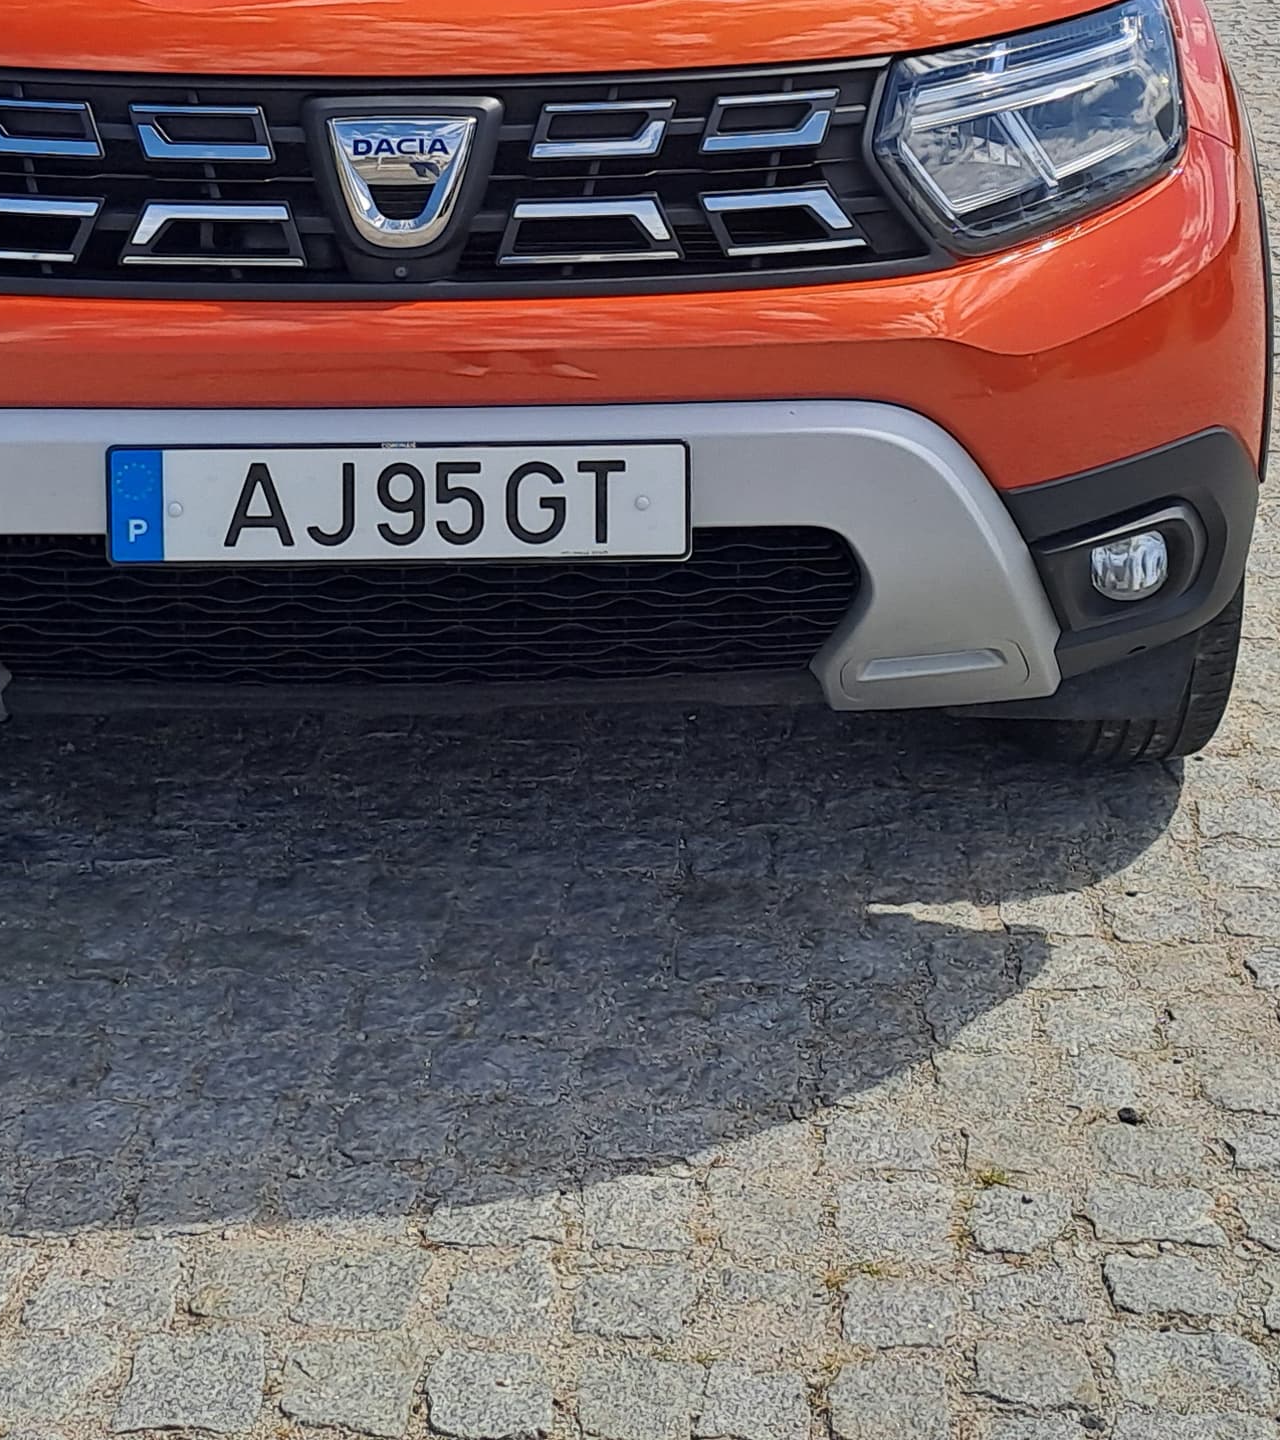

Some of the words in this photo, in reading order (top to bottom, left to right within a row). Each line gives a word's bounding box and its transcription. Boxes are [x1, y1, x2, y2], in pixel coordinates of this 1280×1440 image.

[353, 138, 449, 155] DACIA
[223, 460, 627, 547] AJ95GT
[128, 519, 148, 542] P
